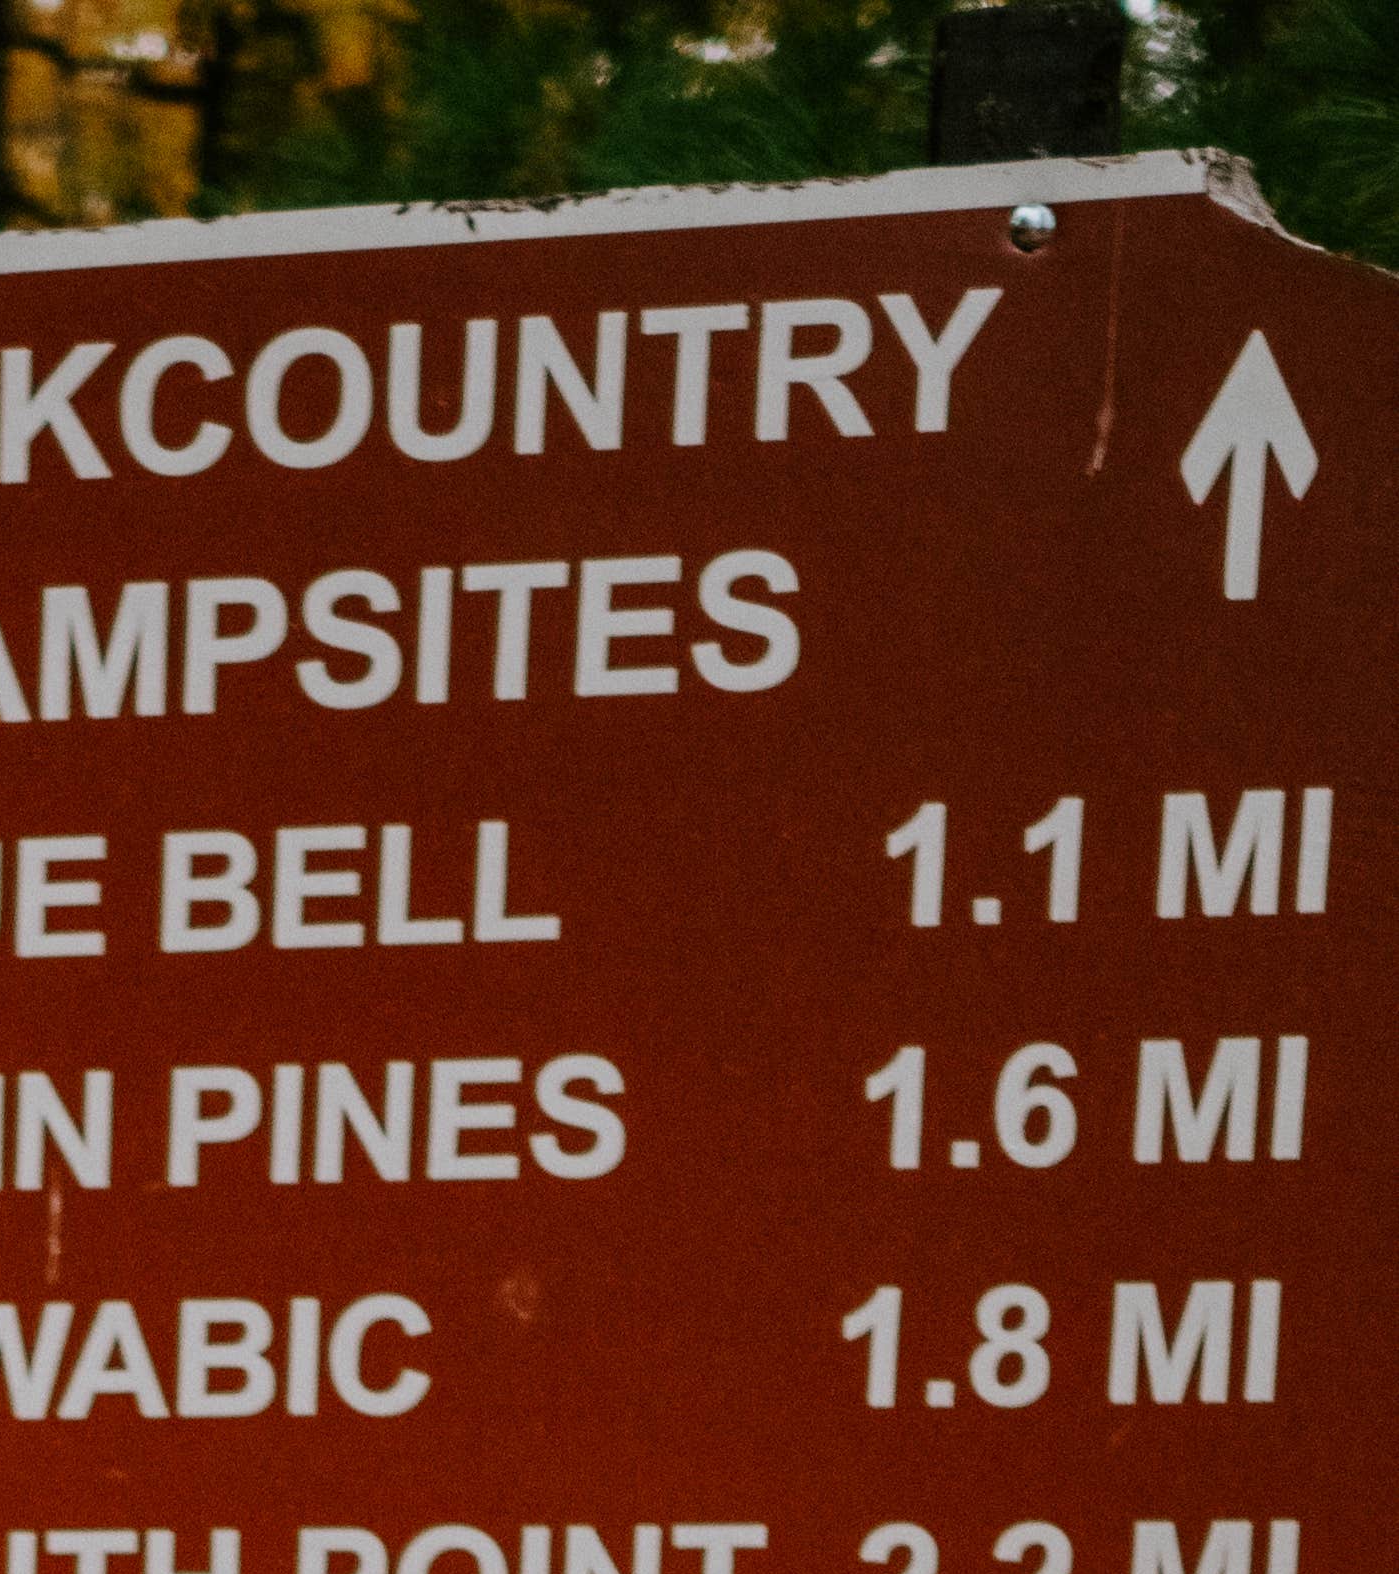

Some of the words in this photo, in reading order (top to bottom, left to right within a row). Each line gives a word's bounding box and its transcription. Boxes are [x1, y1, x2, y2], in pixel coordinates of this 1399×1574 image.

[160, 820, 561, 953] BELL
[886, 797, 1084, 927] 1.1
[1157, 787, 1333, 919] MI
[167, 1054, 626, 1187] PINES
[865, 1042, 1077, 1169] 1.6
[1134, 1035, 1308, 1163] MI
[842, 1284, 1050, 1408] 1.8
[1108, 1279, 1281, 1404] MI
